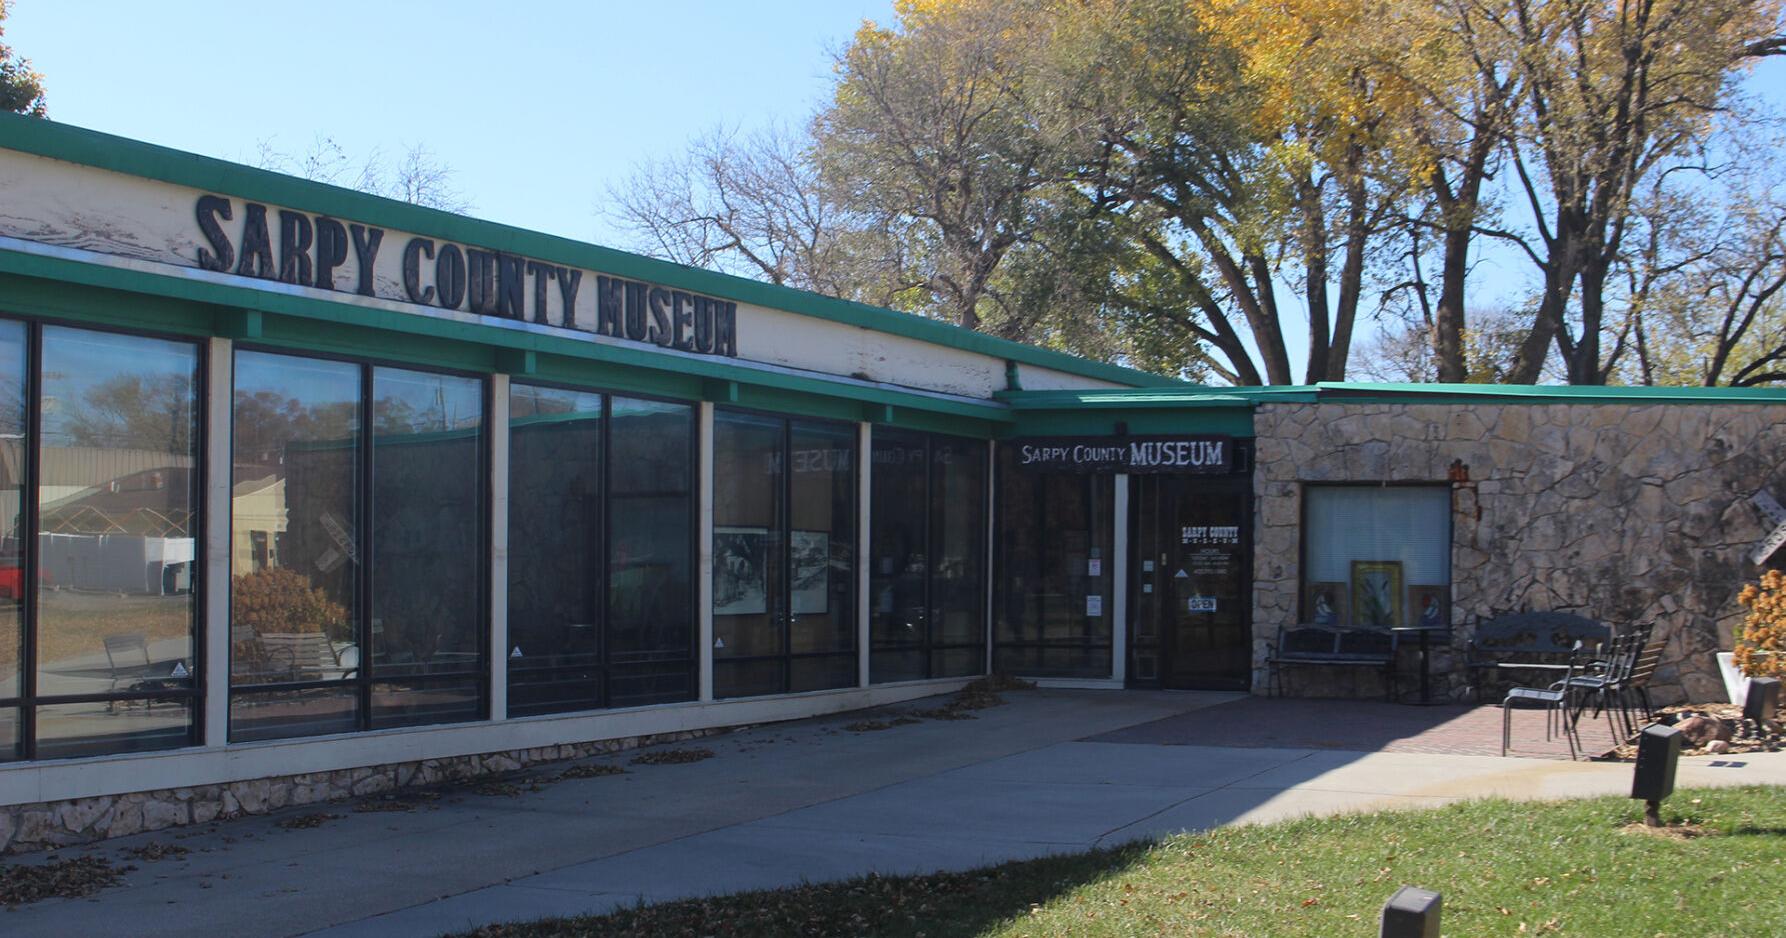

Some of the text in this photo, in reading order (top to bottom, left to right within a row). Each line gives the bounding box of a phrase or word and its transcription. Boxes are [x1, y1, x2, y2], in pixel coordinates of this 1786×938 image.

[196, 195, 738, 357] SARPY COUNTY MUSEUM
[1022, 441, 1223, 466] SARPY COUNTY MUSEUM
